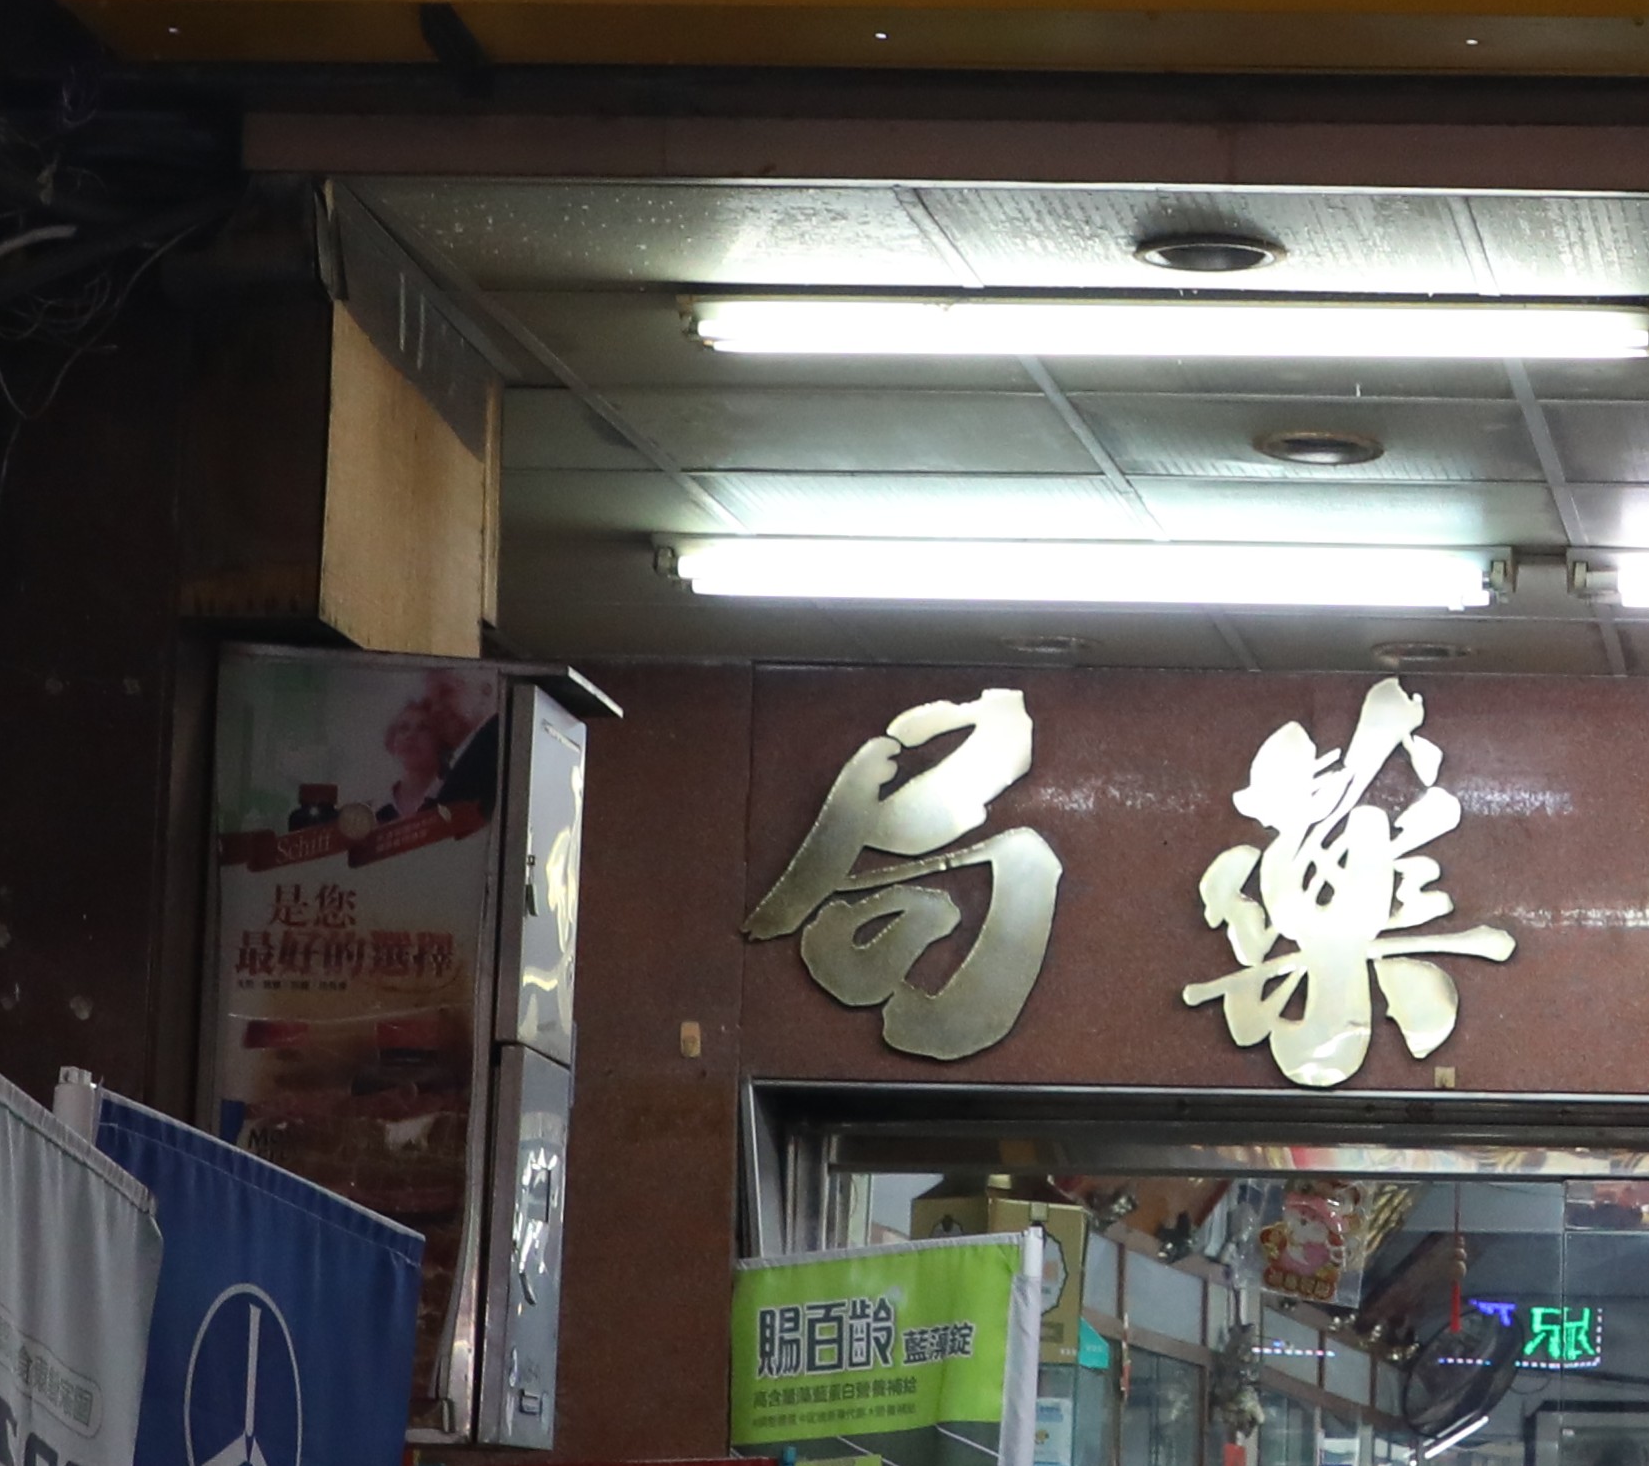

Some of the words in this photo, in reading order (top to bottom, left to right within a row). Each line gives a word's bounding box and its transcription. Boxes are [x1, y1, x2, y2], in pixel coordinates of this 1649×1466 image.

[276, 832, 332, 864] Schiff
[270, 884, 357, 930] 是您
[236, 931, 454, 978] 最好的選擇
[757, 1297, 894, 1377] 賜百齡
